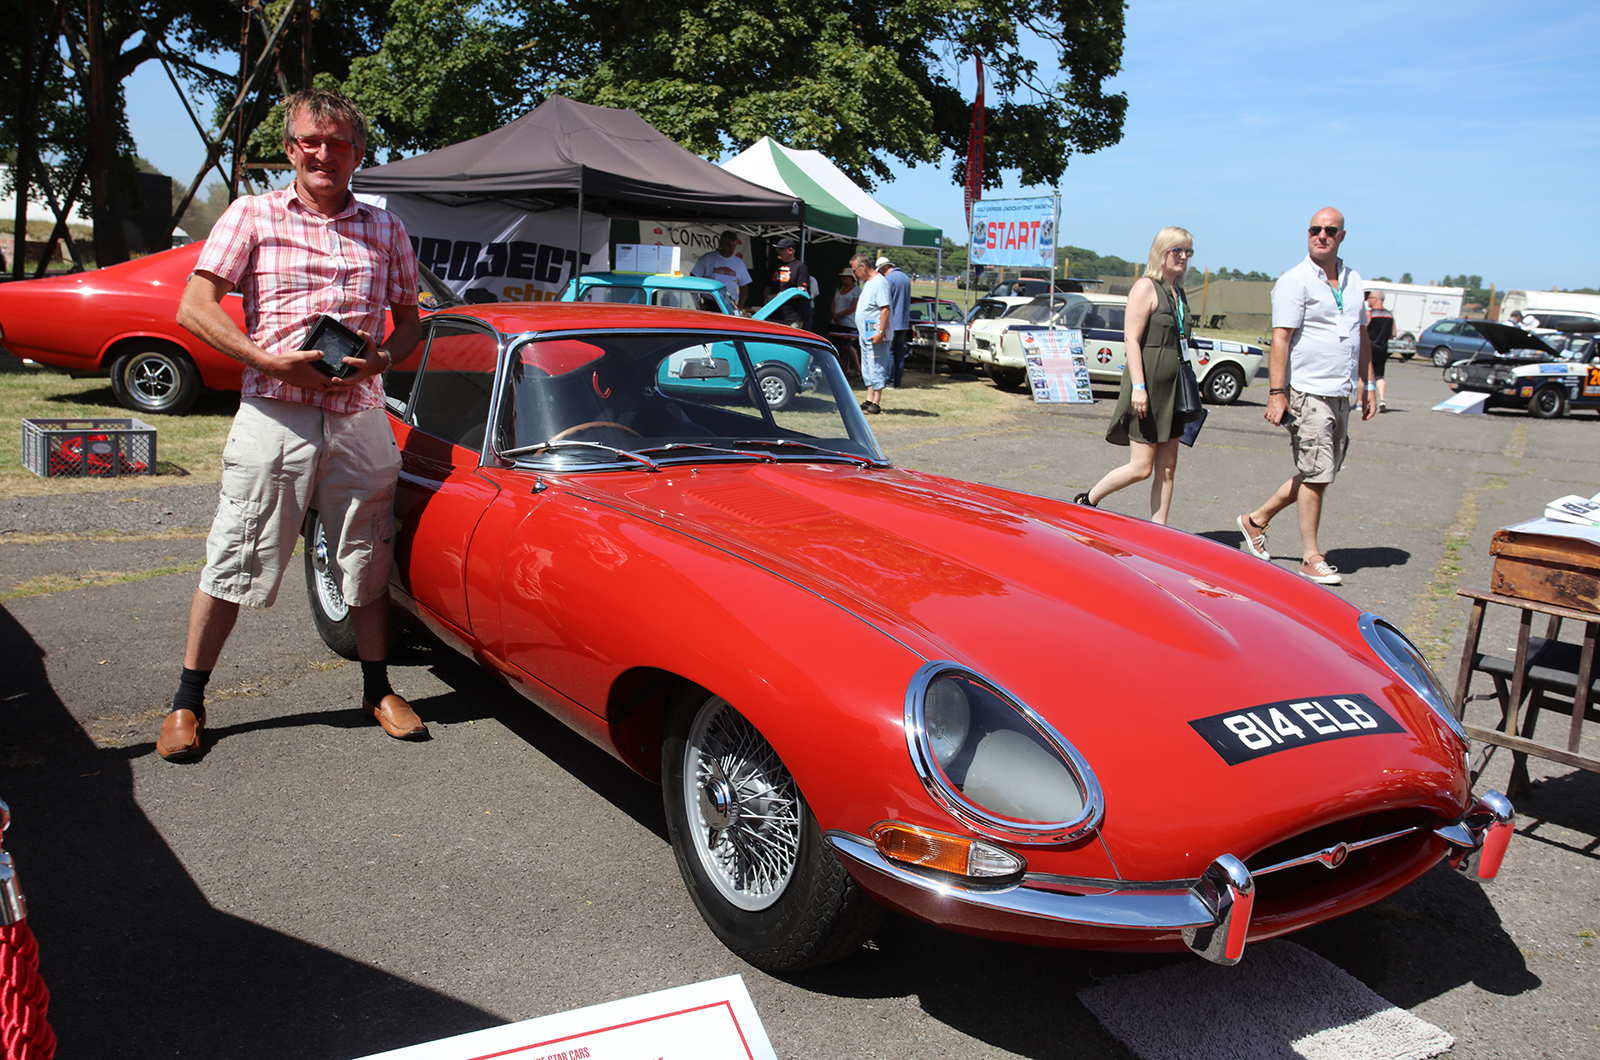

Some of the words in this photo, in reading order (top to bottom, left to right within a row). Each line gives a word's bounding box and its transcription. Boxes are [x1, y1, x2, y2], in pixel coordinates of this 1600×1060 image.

[669, 229, 720, 251] CONTRO
[986, 220, 1041, 250] START
[1589, 369, 1600, 386] 2
[1222, 707, 1307, 750] 814
[1288, 698, 1378, 736] ELB
[568, 1046, 591, 1060] CARS
